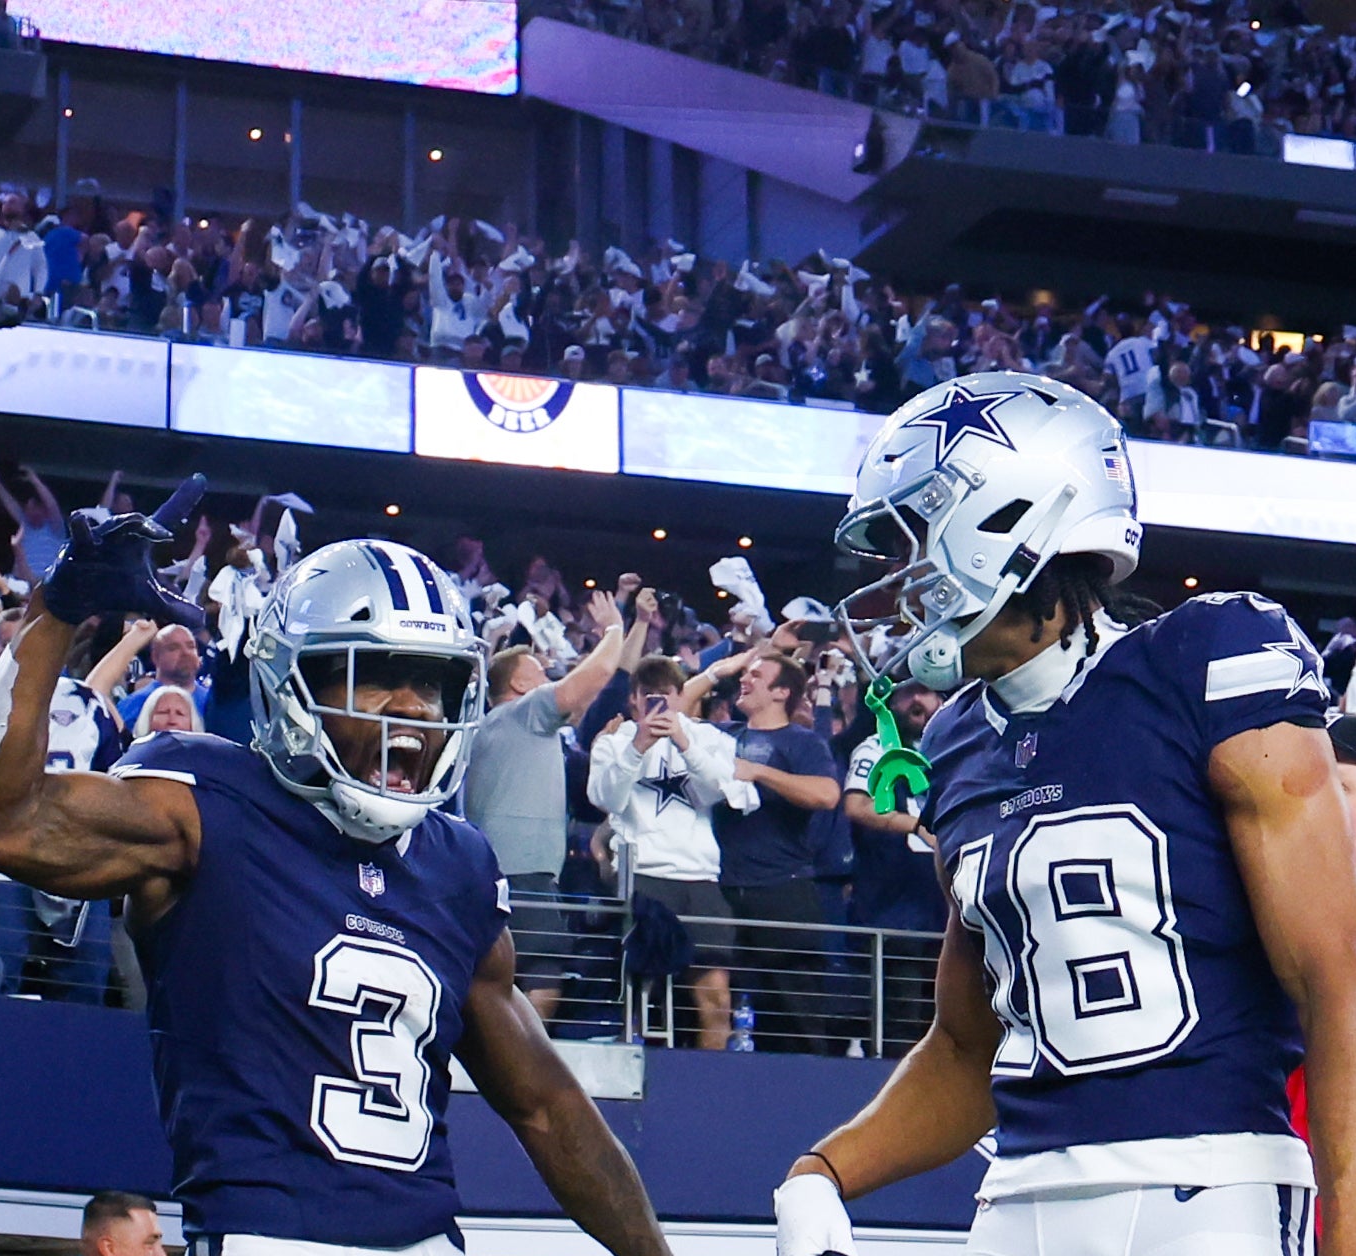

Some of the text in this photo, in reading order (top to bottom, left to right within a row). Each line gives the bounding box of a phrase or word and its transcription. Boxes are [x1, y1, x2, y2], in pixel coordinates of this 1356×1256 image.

[487, 403, 552, 432] BEER
[310, 933, 442, 1172] 3
[951, 804, 1200, 1077] 18
